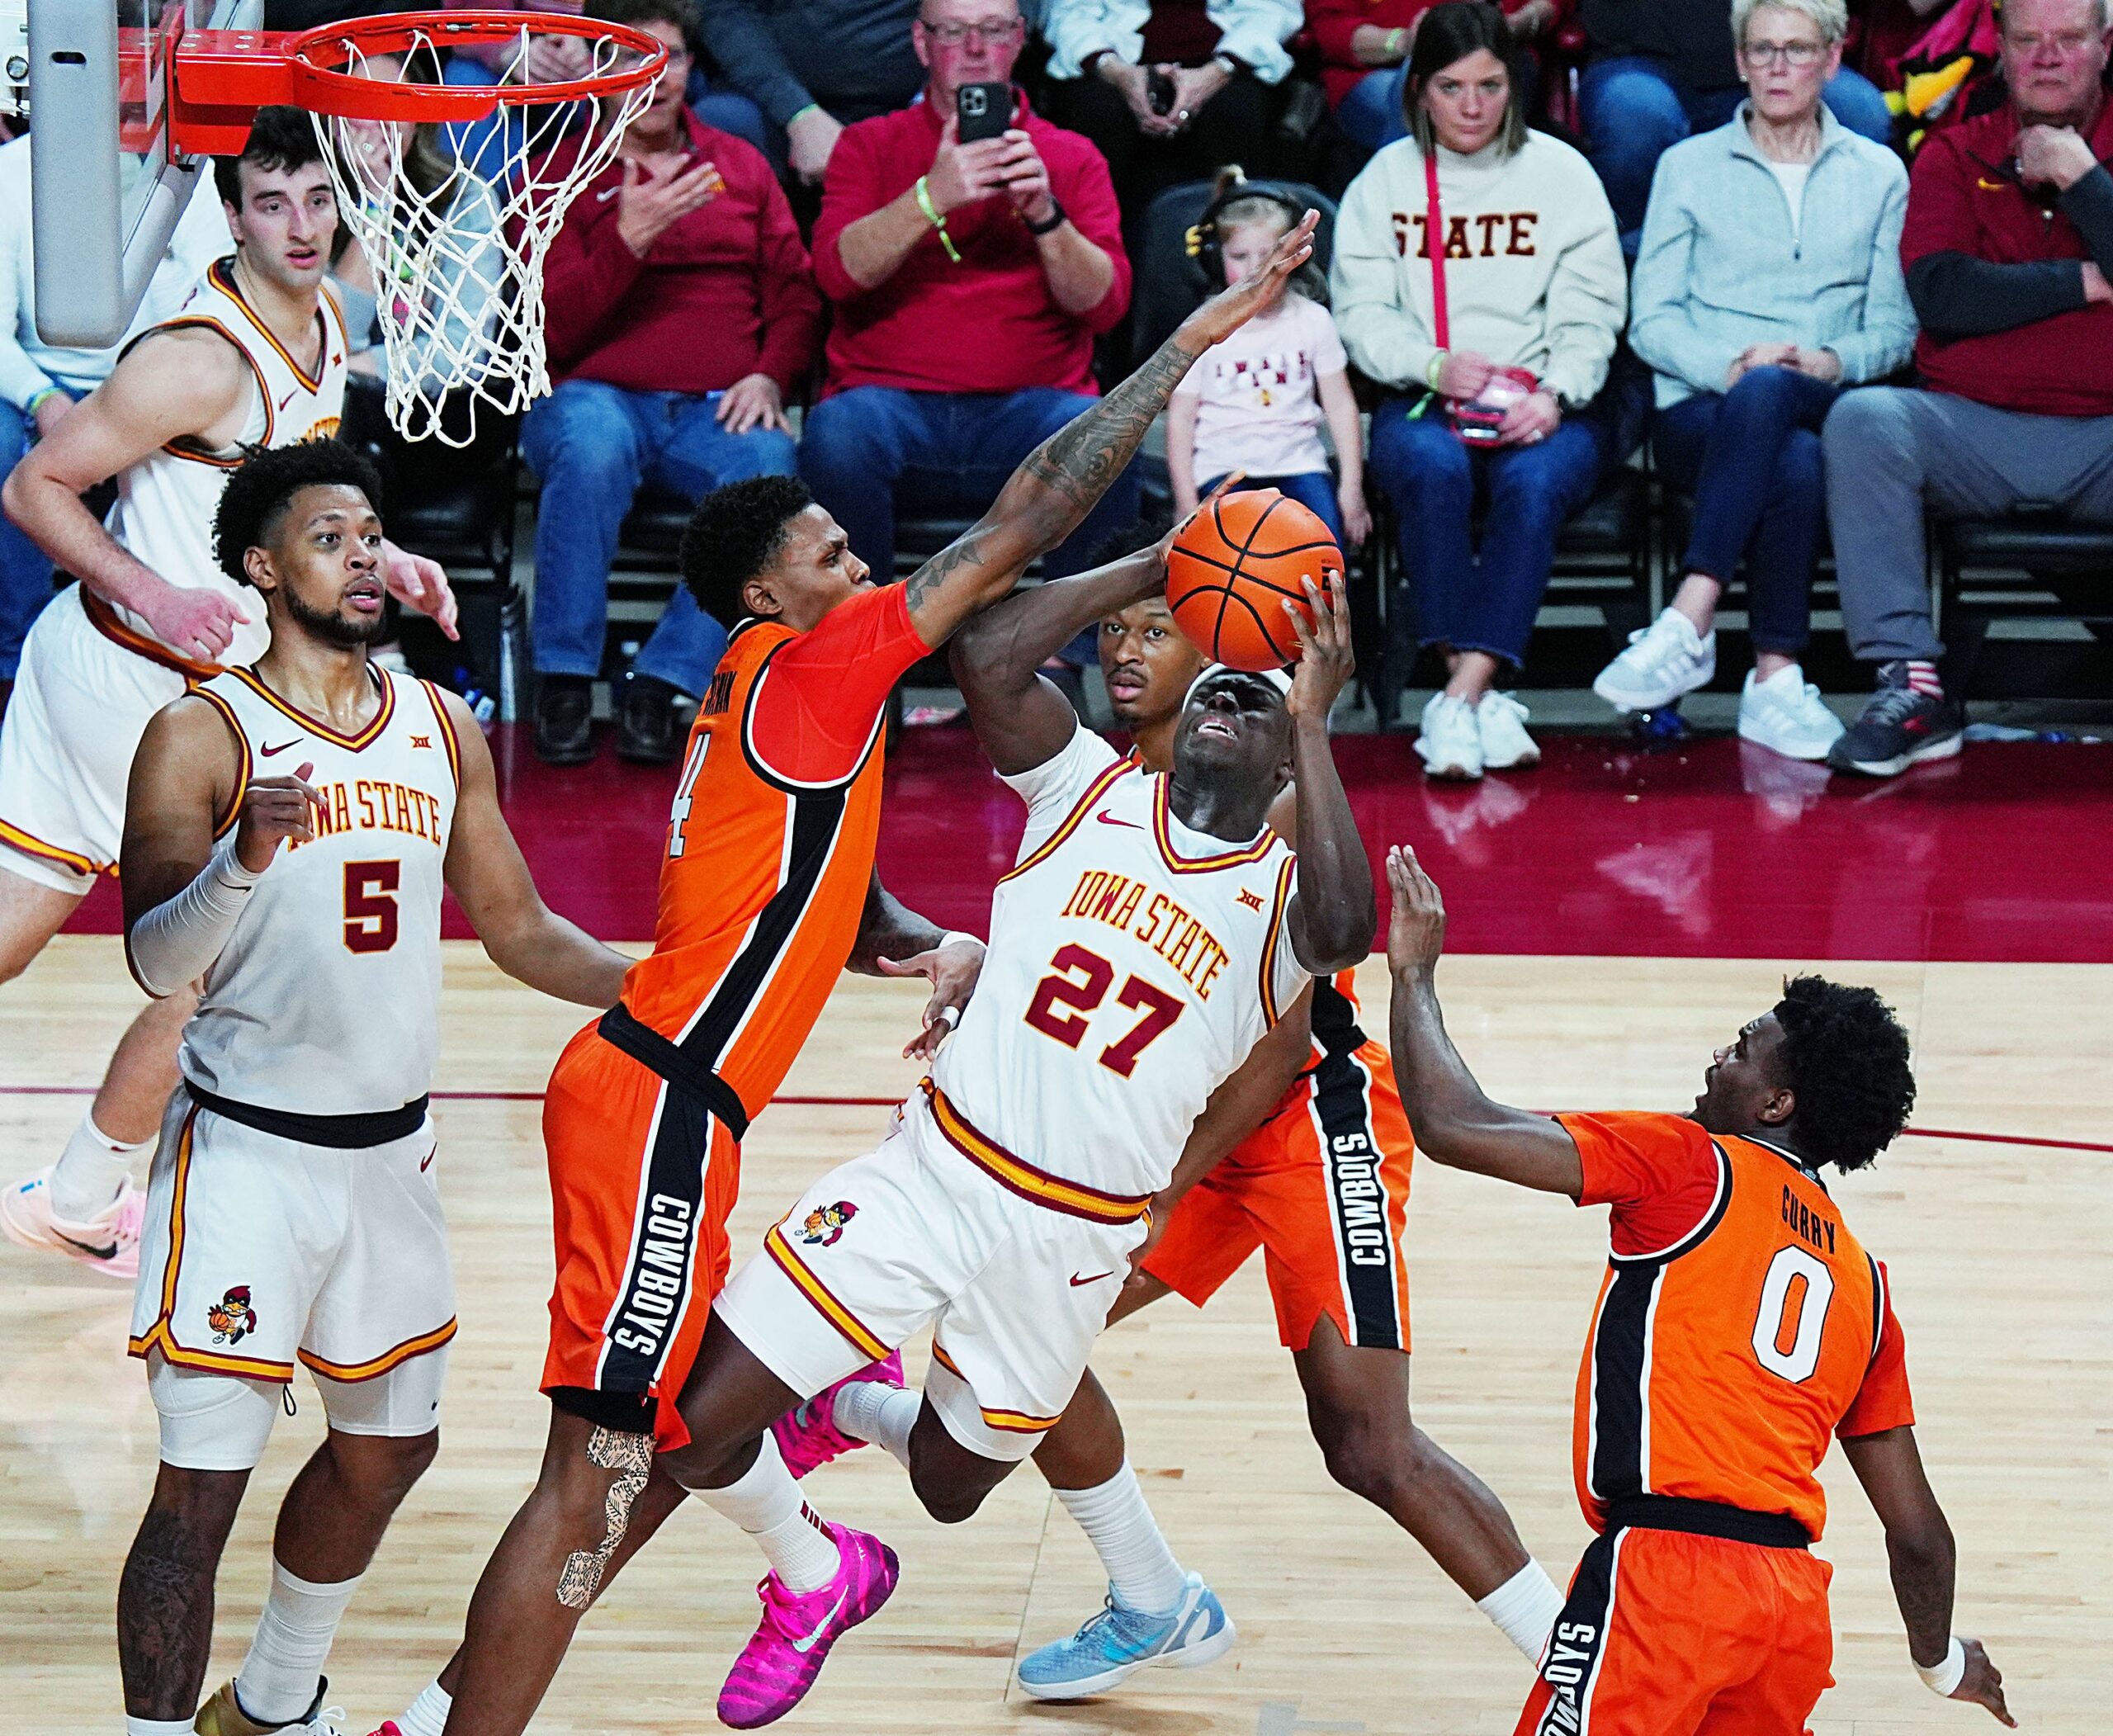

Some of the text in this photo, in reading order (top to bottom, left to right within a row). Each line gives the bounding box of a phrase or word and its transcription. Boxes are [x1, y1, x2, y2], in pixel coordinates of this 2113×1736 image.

[1392, 212, 1538, 258] STATE
[355, 778, 442, 846] STATE
[343, 859, 400, 955] 5
[1061, 870, 1231, 1004] IOWA STATE
[1236, 887, 1265, 913] XII
[1023, 943, 1188, 1081] 27
[1782, 1183, 1835, 1255] CURRY
[615, 1193, 691, 1356] COWBOYS
[1751, 1243, 1835, 1384] 0
